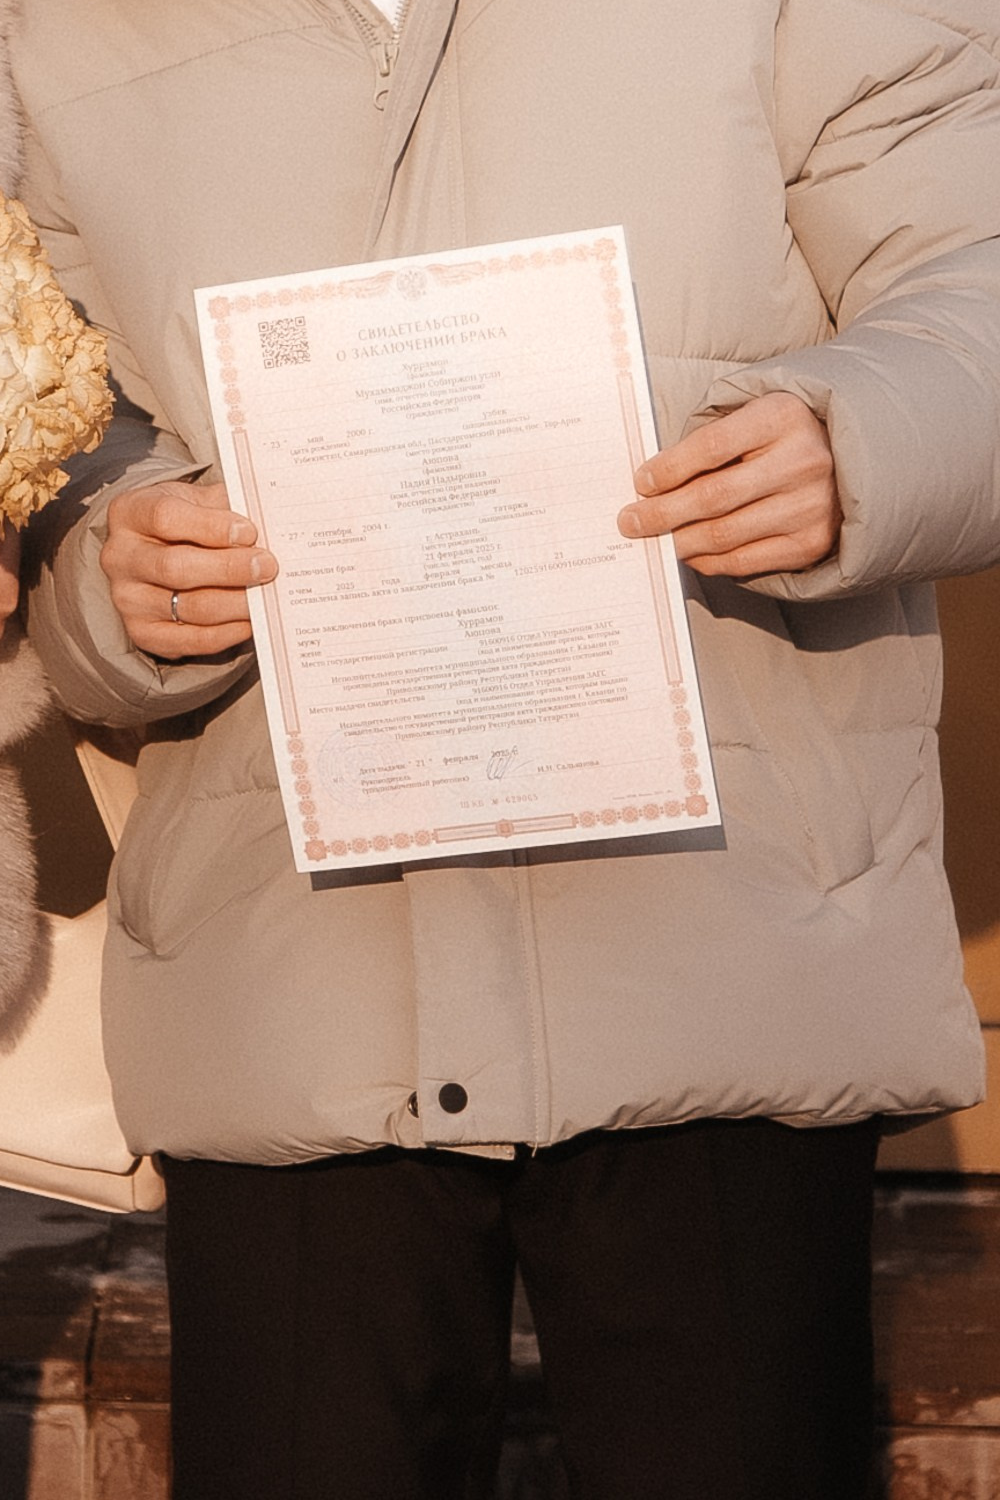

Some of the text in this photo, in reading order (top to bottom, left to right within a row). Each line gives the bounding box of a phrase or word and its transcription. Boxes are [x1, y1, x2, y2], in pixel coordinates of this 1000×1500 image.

[357, 312, 481, 342] СВИДЕТЕЛЬСТВО
[350, 333, 455, 359] ЗАКЛЮЧЕНИИ
[459, 325, 507, 343] БРАКА
[381, 392, 481, 414] Российская Федерация
[421, 453, 459, 466] Аюпова
[396, 487, 496, 508] Российская Федерация
[475, 543, 495, 553] 2025
[335, 563, 355, 573] брак
[335, 582, 354, 591] 2025
[381, 577, 400, 586] года
[297, 638, 321, 648] мужу
